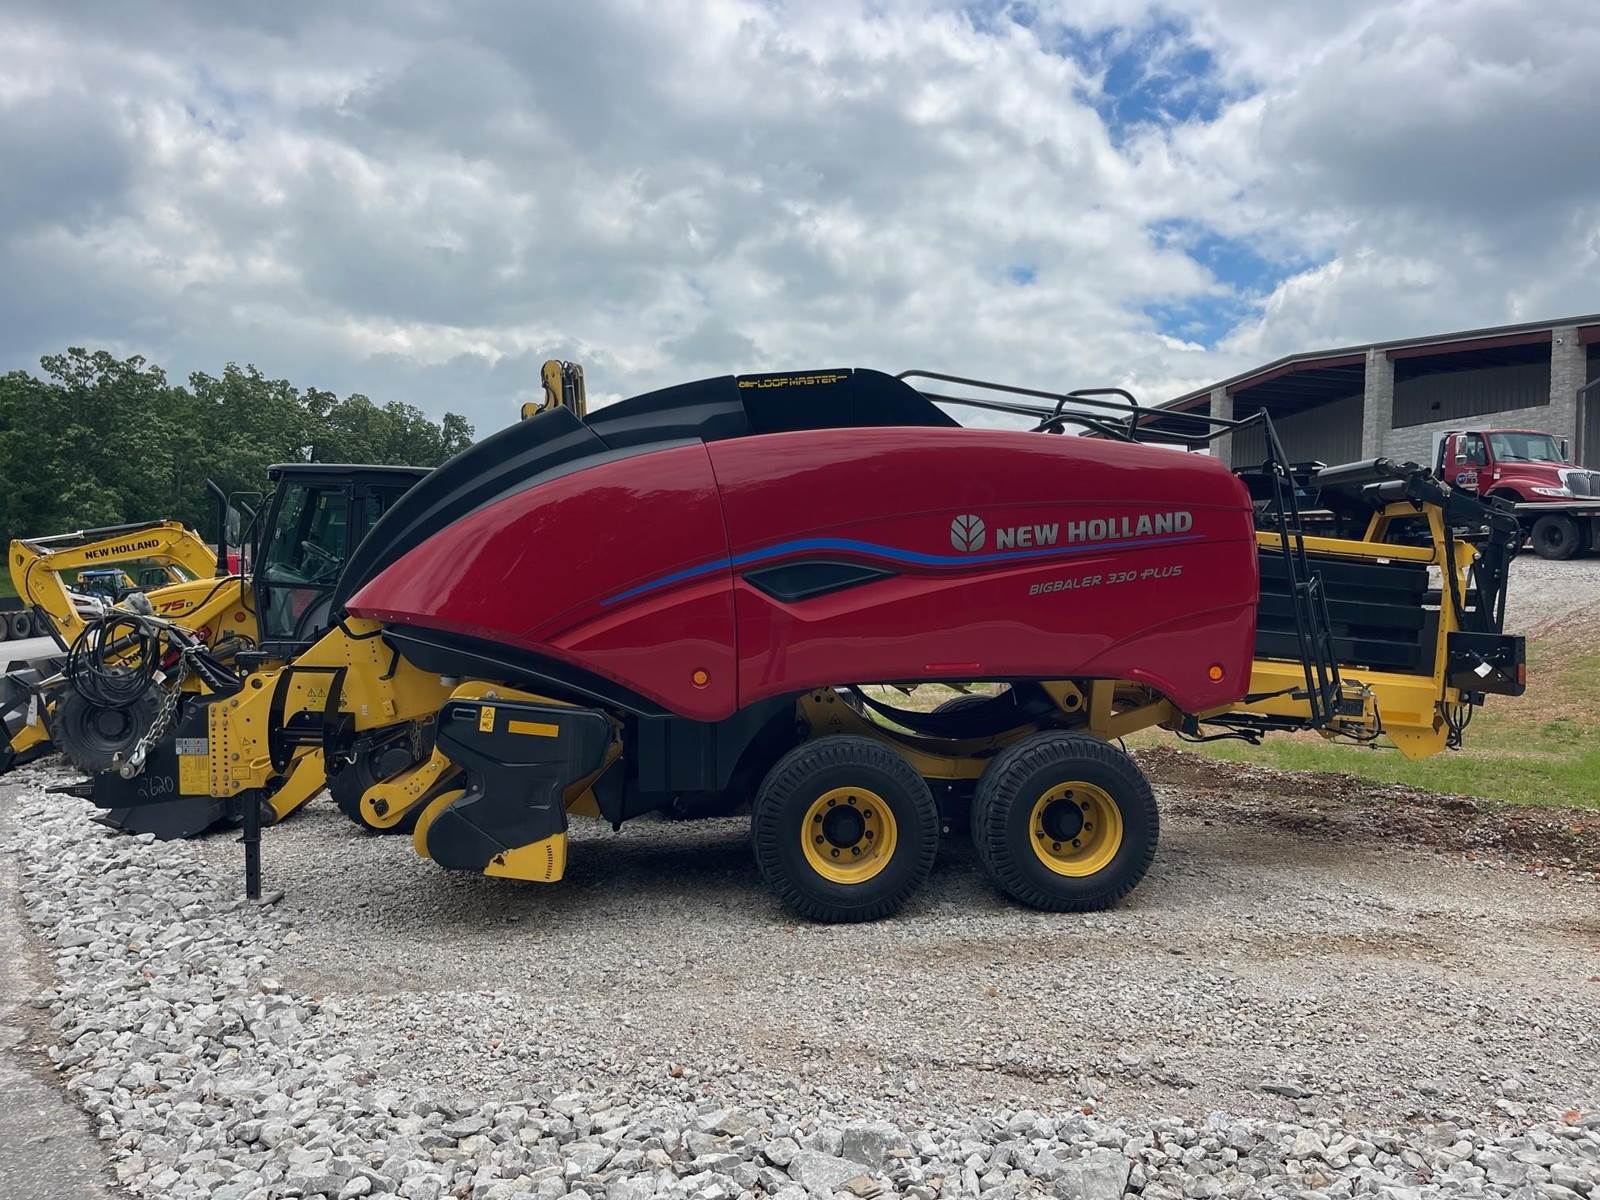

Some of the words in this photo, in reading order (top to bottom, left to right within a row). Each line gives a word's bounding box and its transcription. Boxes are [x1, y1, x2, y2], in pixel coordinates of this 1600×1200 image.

[996, 523, 1059, 550] NEW
[1068, 511, 1193, 543] HOLLAND
[85, 548, 109, 560] NEW
[111, 539, 160, 555] HOLLAND
[1028, 575, 1102, 596] BIGBALER
[1106, 570, 1137, 584] 330
